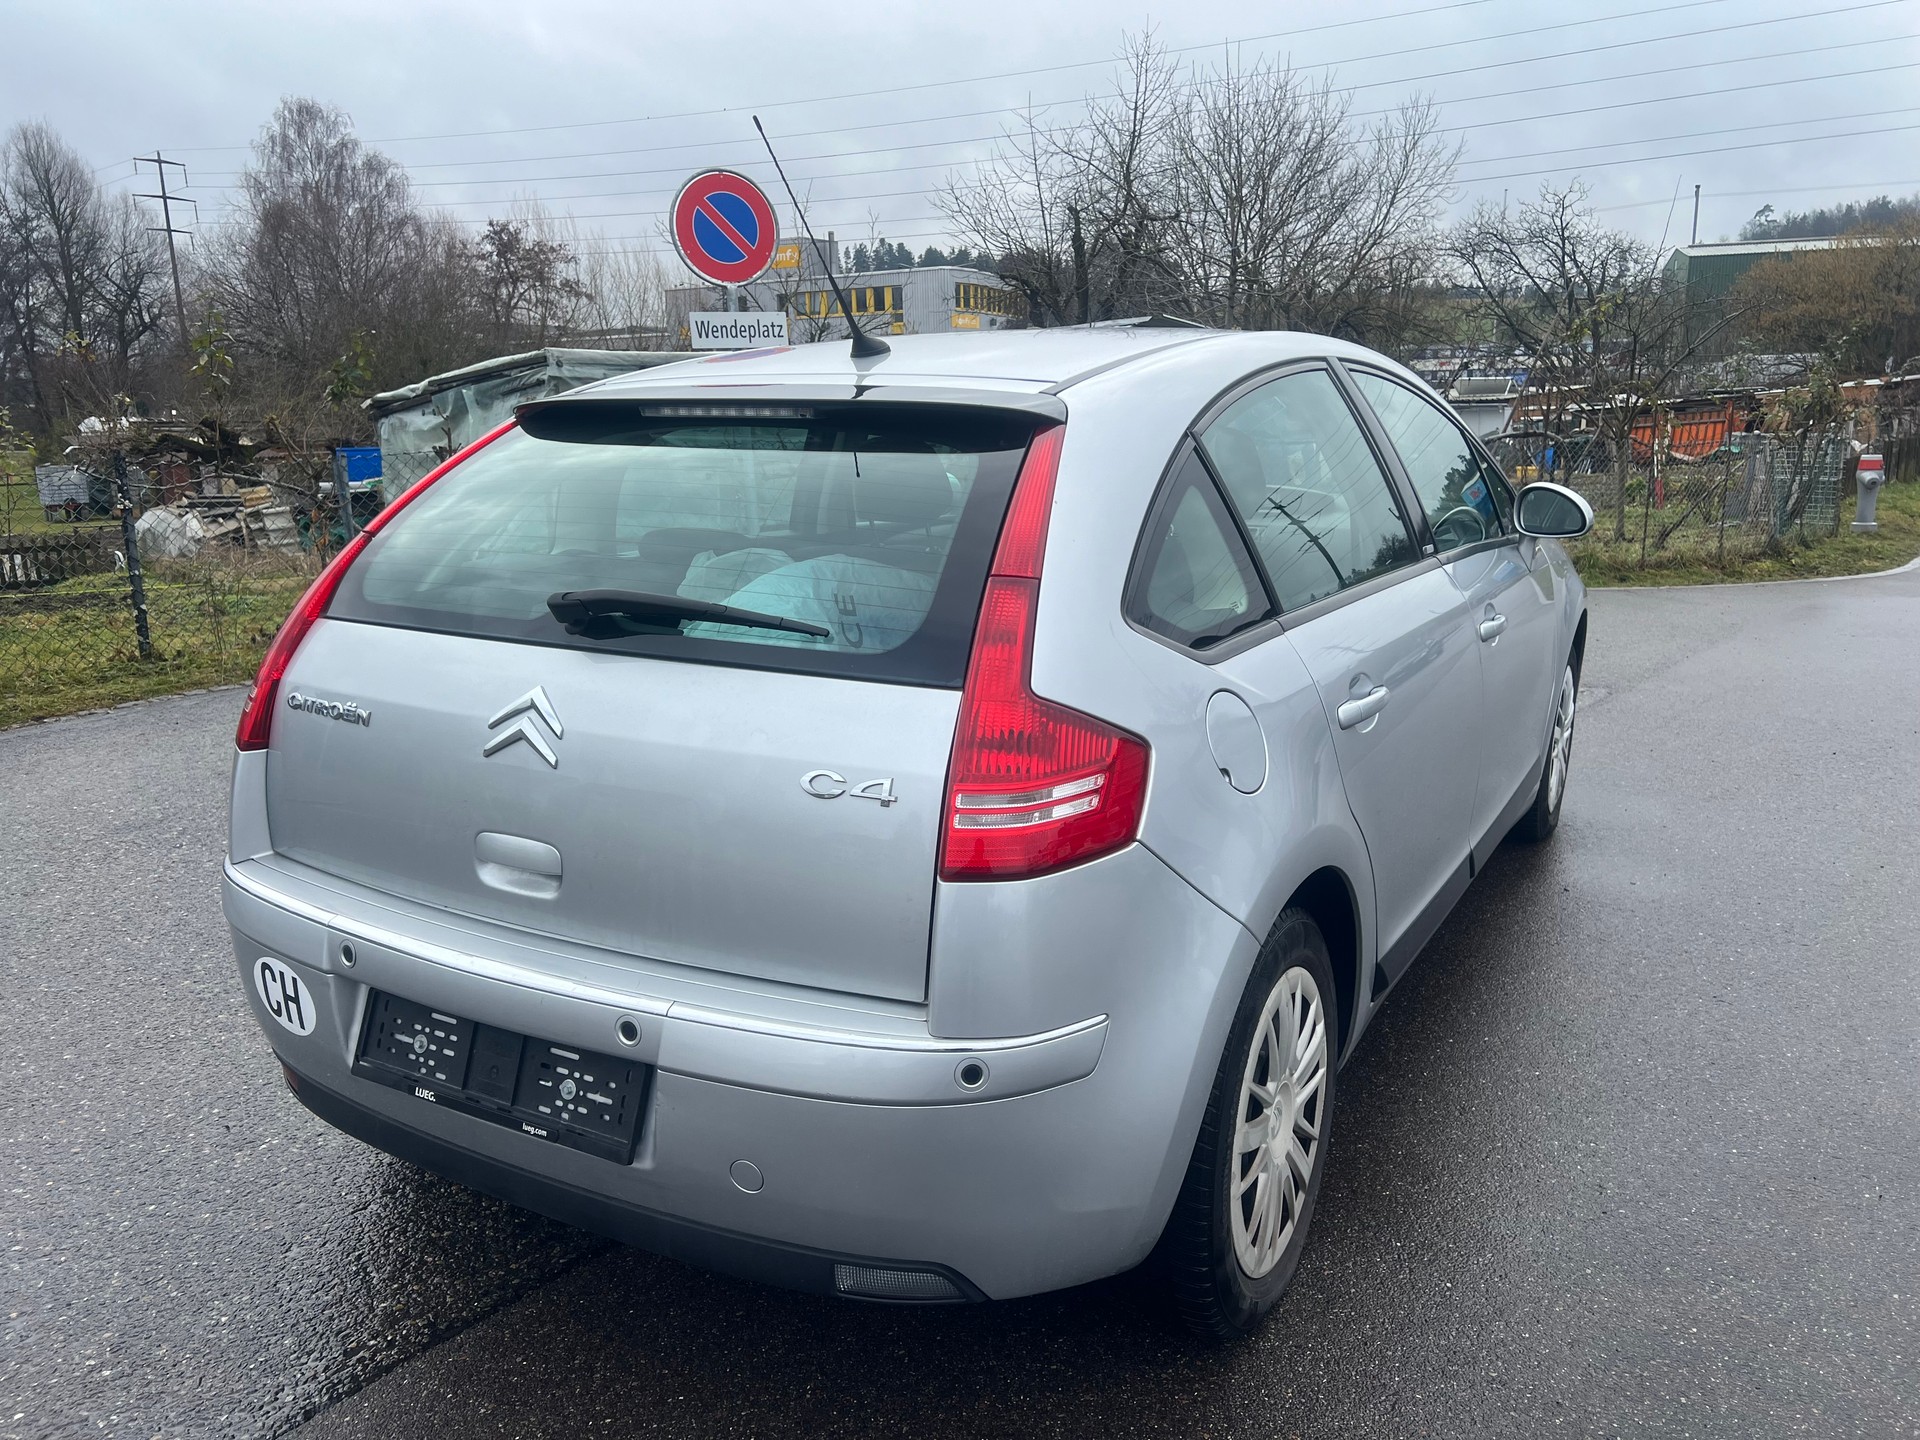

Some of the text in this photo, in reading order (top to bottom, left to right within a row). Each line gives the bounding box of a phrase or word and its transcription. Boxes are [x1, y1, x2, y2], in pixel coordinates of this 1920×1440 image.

[773, 249, 798, 262] mfy
[695, 319, 784, 343] Wendeplatz
[834, 593, 863, 648] CE
[287, 692, 372, 727] CITROËN
[800, 769, 898, 807] C4
[261, 962, 305, 1030] CH
[415, 1087, 436, 1102] LUEG.
[522, 1122, 547, 1137] lueg.com
